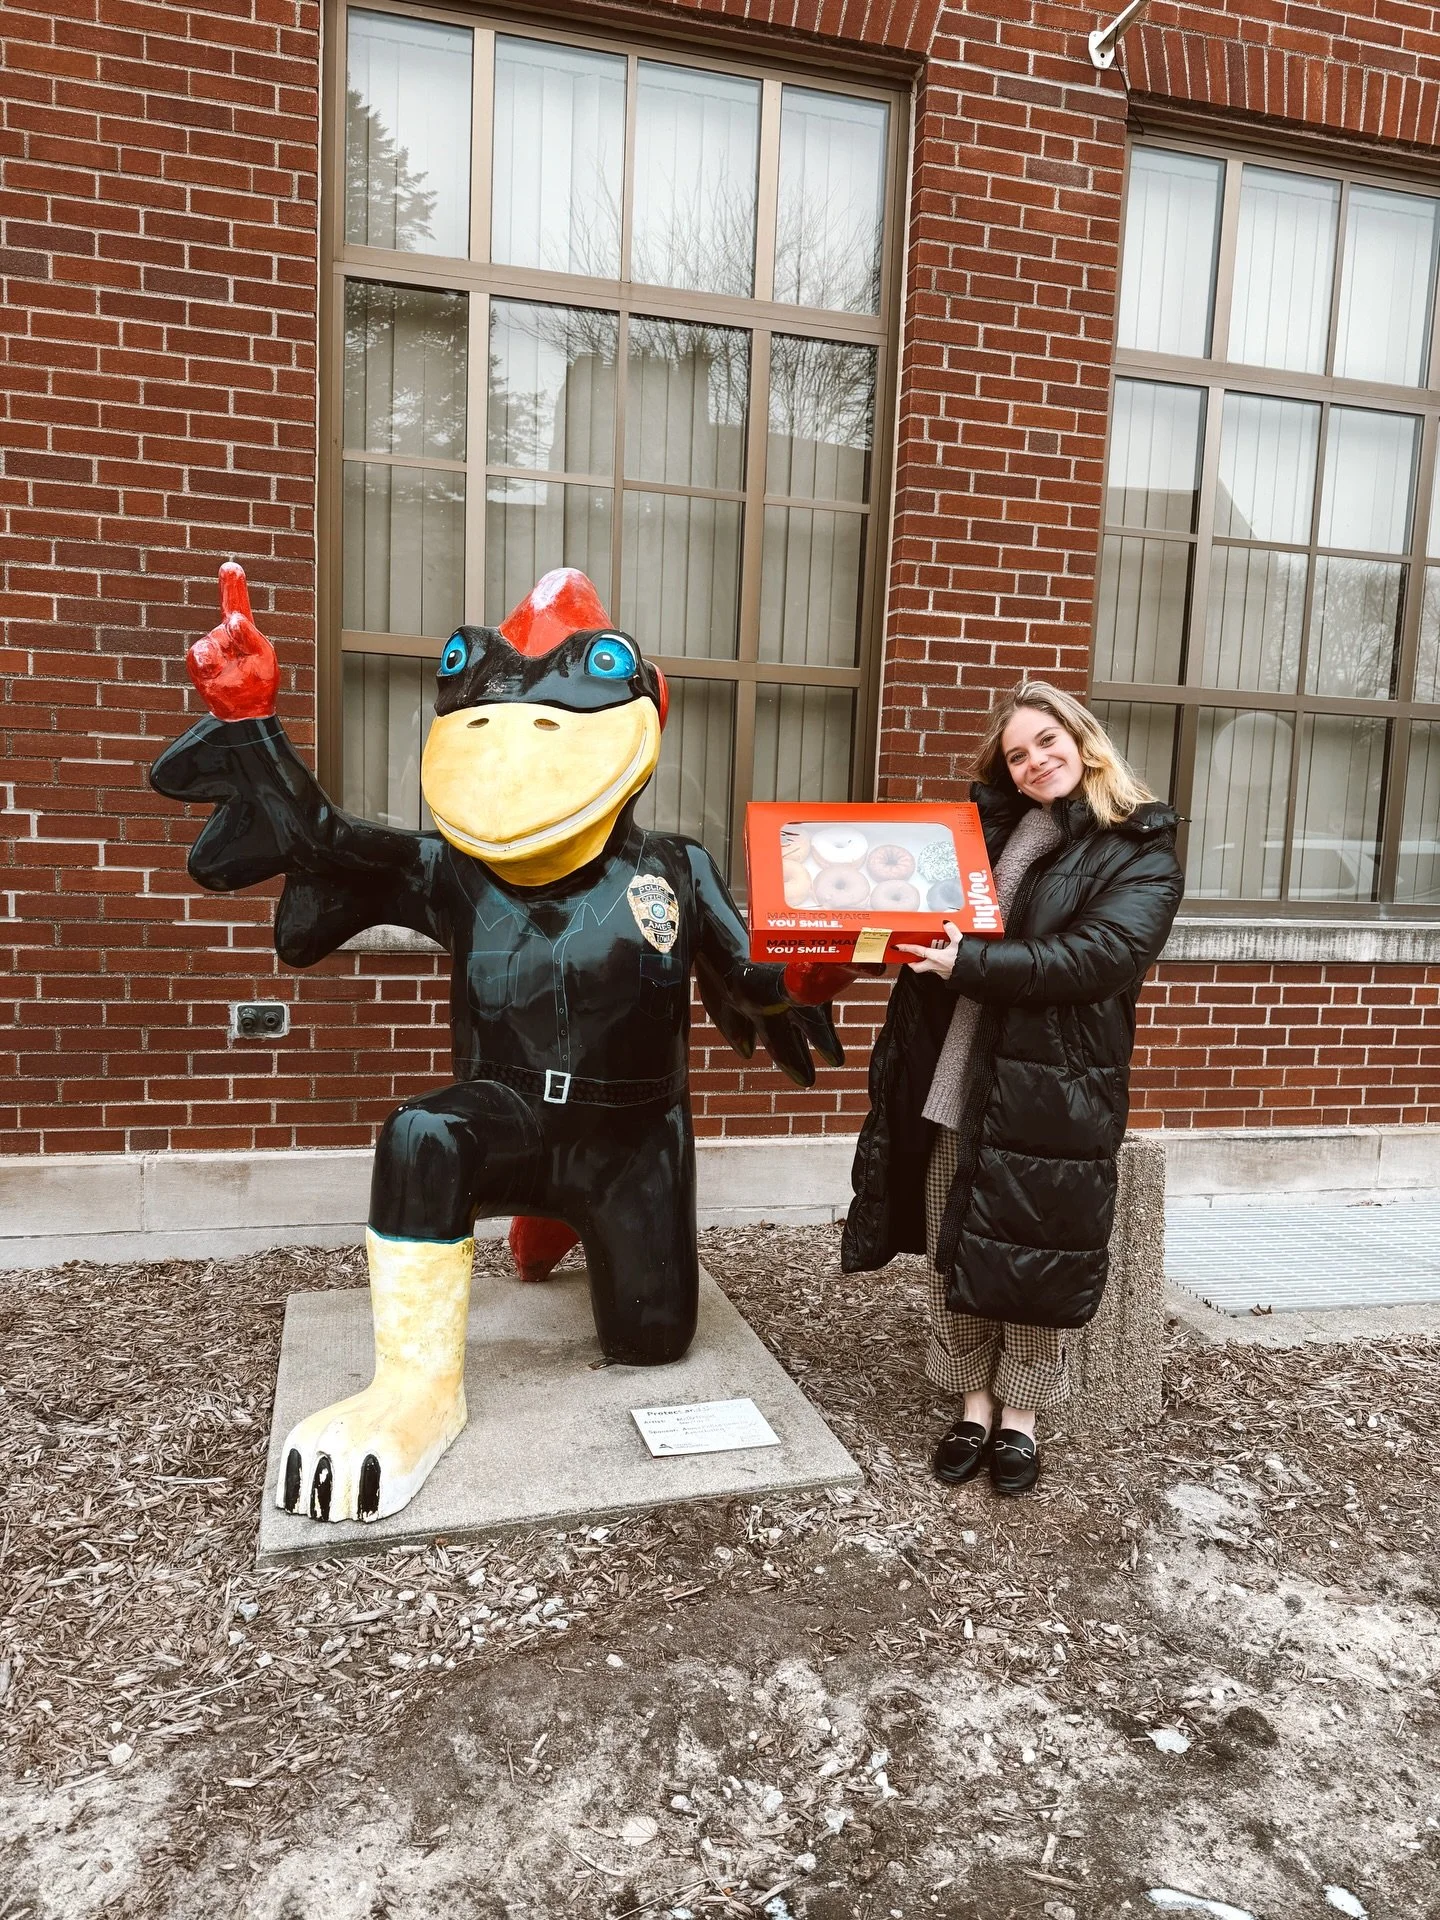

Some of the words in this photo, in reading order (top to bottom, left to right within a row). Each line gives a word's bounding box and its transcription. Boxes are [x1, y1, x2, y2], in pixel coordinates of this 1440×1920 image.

[639, 884, 669, 897] POLICE
[831, 912, 871, 920] MAKE
[648, 920, 672, 931] AMES
[767, 919, 796, 927] YOU
[799, 919, 843, 928] SMILE.
[656, 934, 671, 943] IOWA
[766, 938, 805, 946] MADE
[766, 946, 793, 954] YOU
[797, 946, 840, 954] SMILE.
